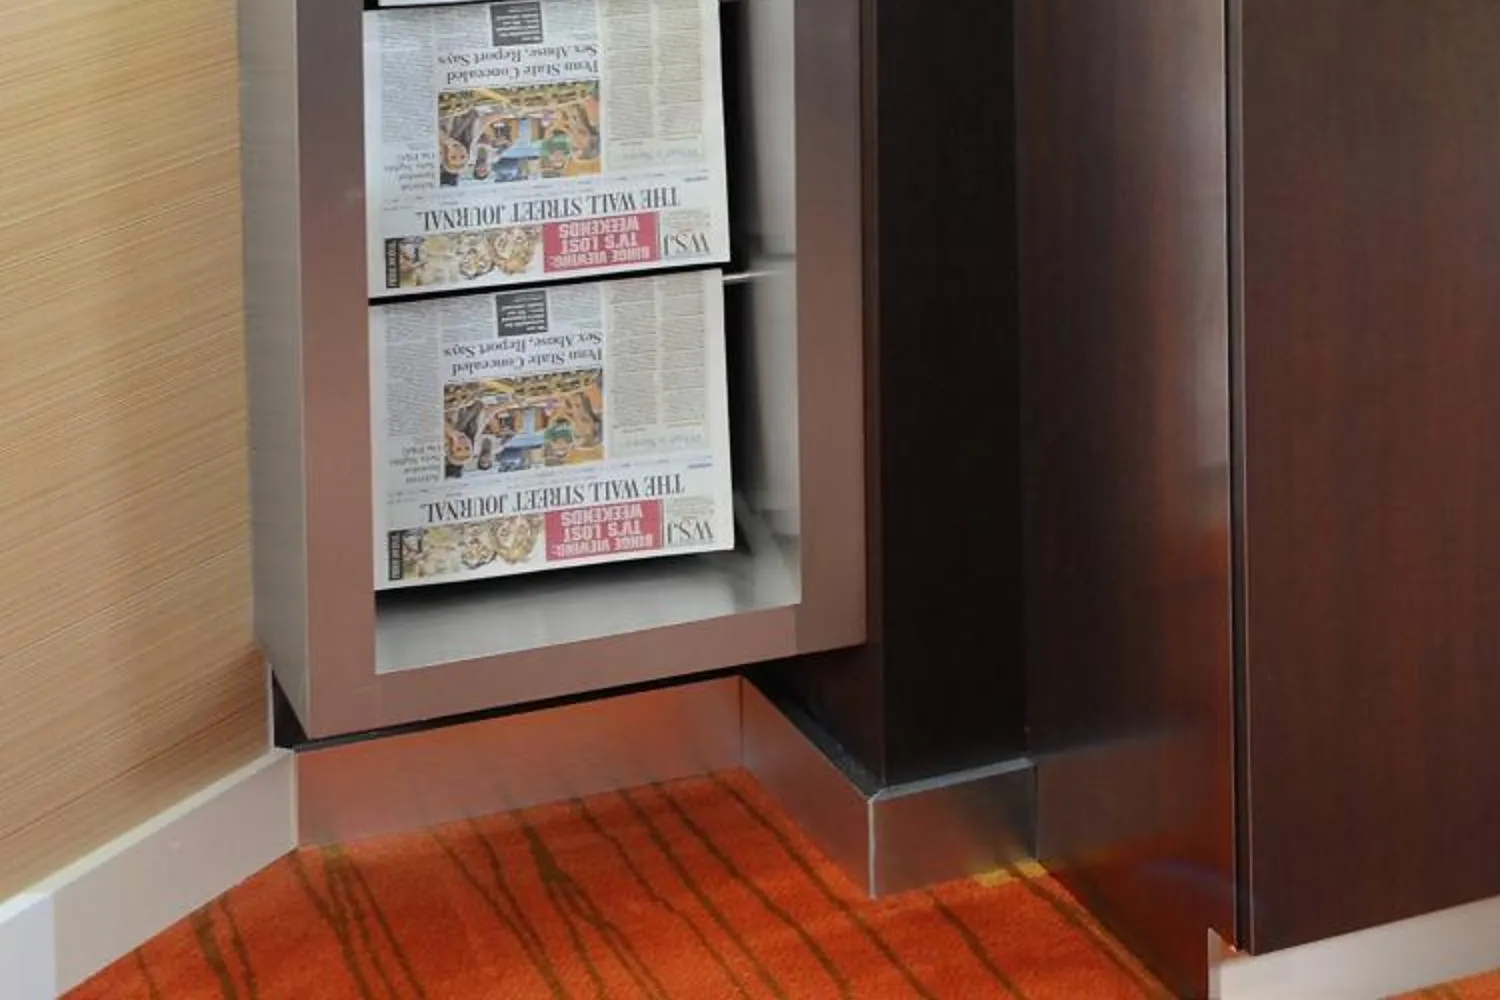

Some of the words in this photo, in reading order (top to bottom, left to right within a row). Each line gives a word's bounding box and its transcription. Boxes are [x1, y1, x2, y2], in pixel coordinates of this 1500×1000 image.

[438, 52, 471, 69] Says
[472, 48, 521, 66] Report
[569, 44, 597, 59] Sex
[447, 67, 520, 84] Concealed
[523, 64, 561, 78] State
[586, 192, 636, 213] WALL
[640, 187, 679, 208] THE
[508, 197, 583, 221] STREET
[559, 216, 640, 236] WEEKENDS
[561, 236, 599, 251] LOST
[603, 232, 638, 247] TV'S
[663, 233, 710, 256] WSJ
[478, 336, 526, 354] Report
[576, 331, 602, 346] Sex
[443, 341, 475, 358] Says
[451, 355, 524, 376] Concealed
[528, 352, 565, 367] State
[588, 479, 640, 501] WALL
[644, 473, 684, 496] THE
[510, 484, 585, 510] STREET
[560, 504, 643, 524] WEEKENDS
[563, 524, 602, 540] LOST
[606, 521, 641, 535] TV'S
[666, 520, 713, 545] WSJ
